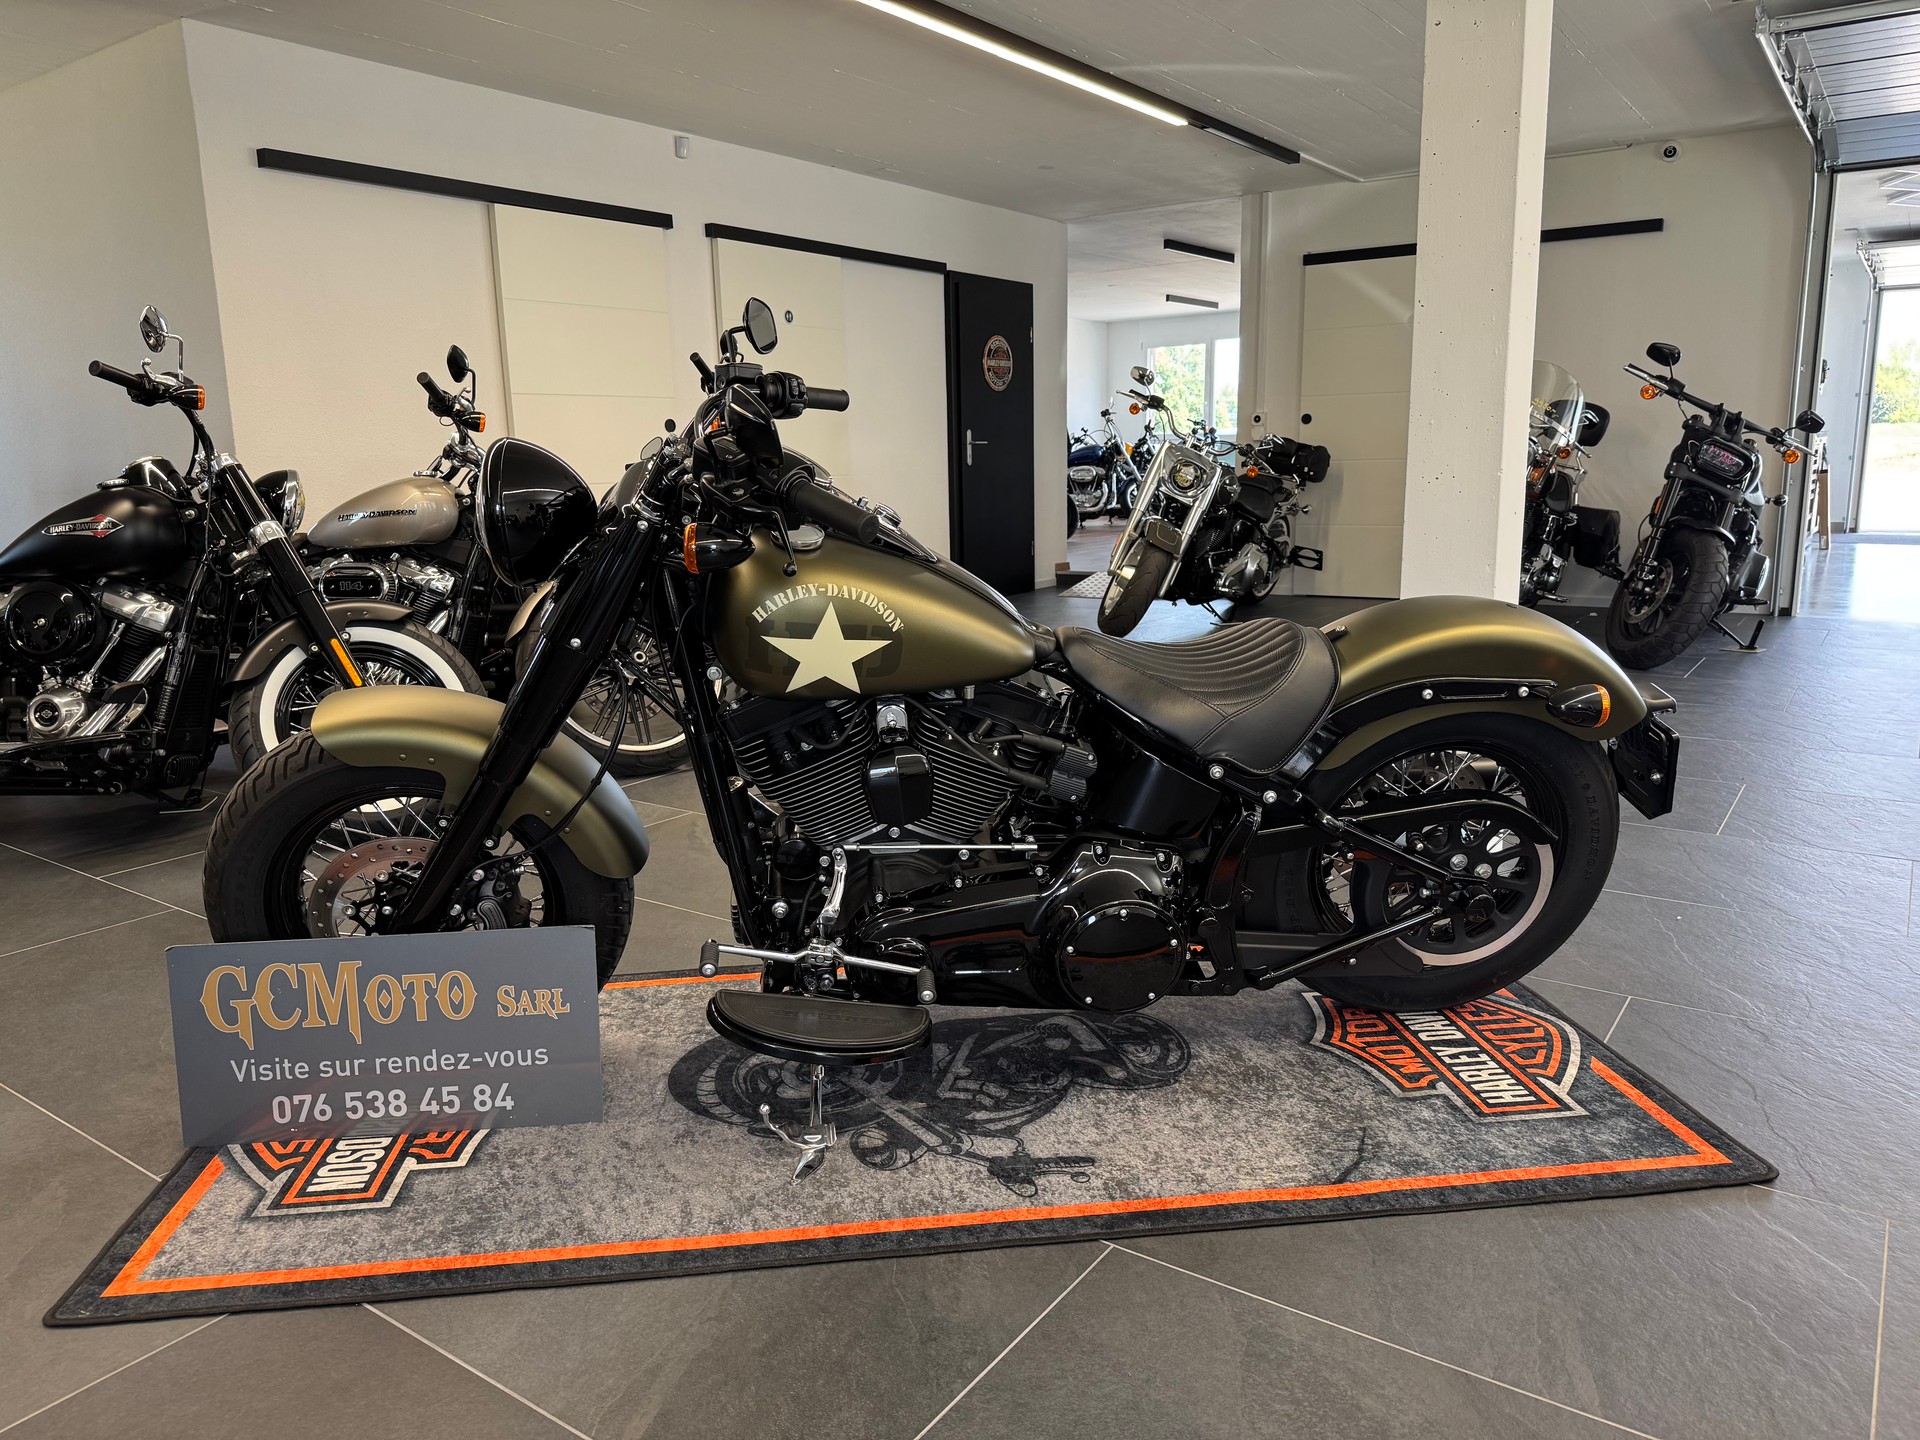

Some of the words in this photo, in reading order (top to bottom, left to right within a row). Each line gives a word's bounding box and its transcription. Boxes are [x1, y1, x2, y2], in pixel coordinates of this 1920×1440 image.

[340, 581, 363, 591] 114
[752, 583, 904, 633] HARLEY-DAVIDSON
[231, 1057, 309, 1082] Visite
[319, 1055, 364, 1079] sur
[375, 1047, 549, 1075] rendez-vous
[1430, 1046, 1537, 1104] HARLEY
[272, 1094, 333, 1124] 076
[345, 1090, 408, 1120] 538
[419, 1087, 461, 1114] 45
[472, 1082, 515, 1112] 84
